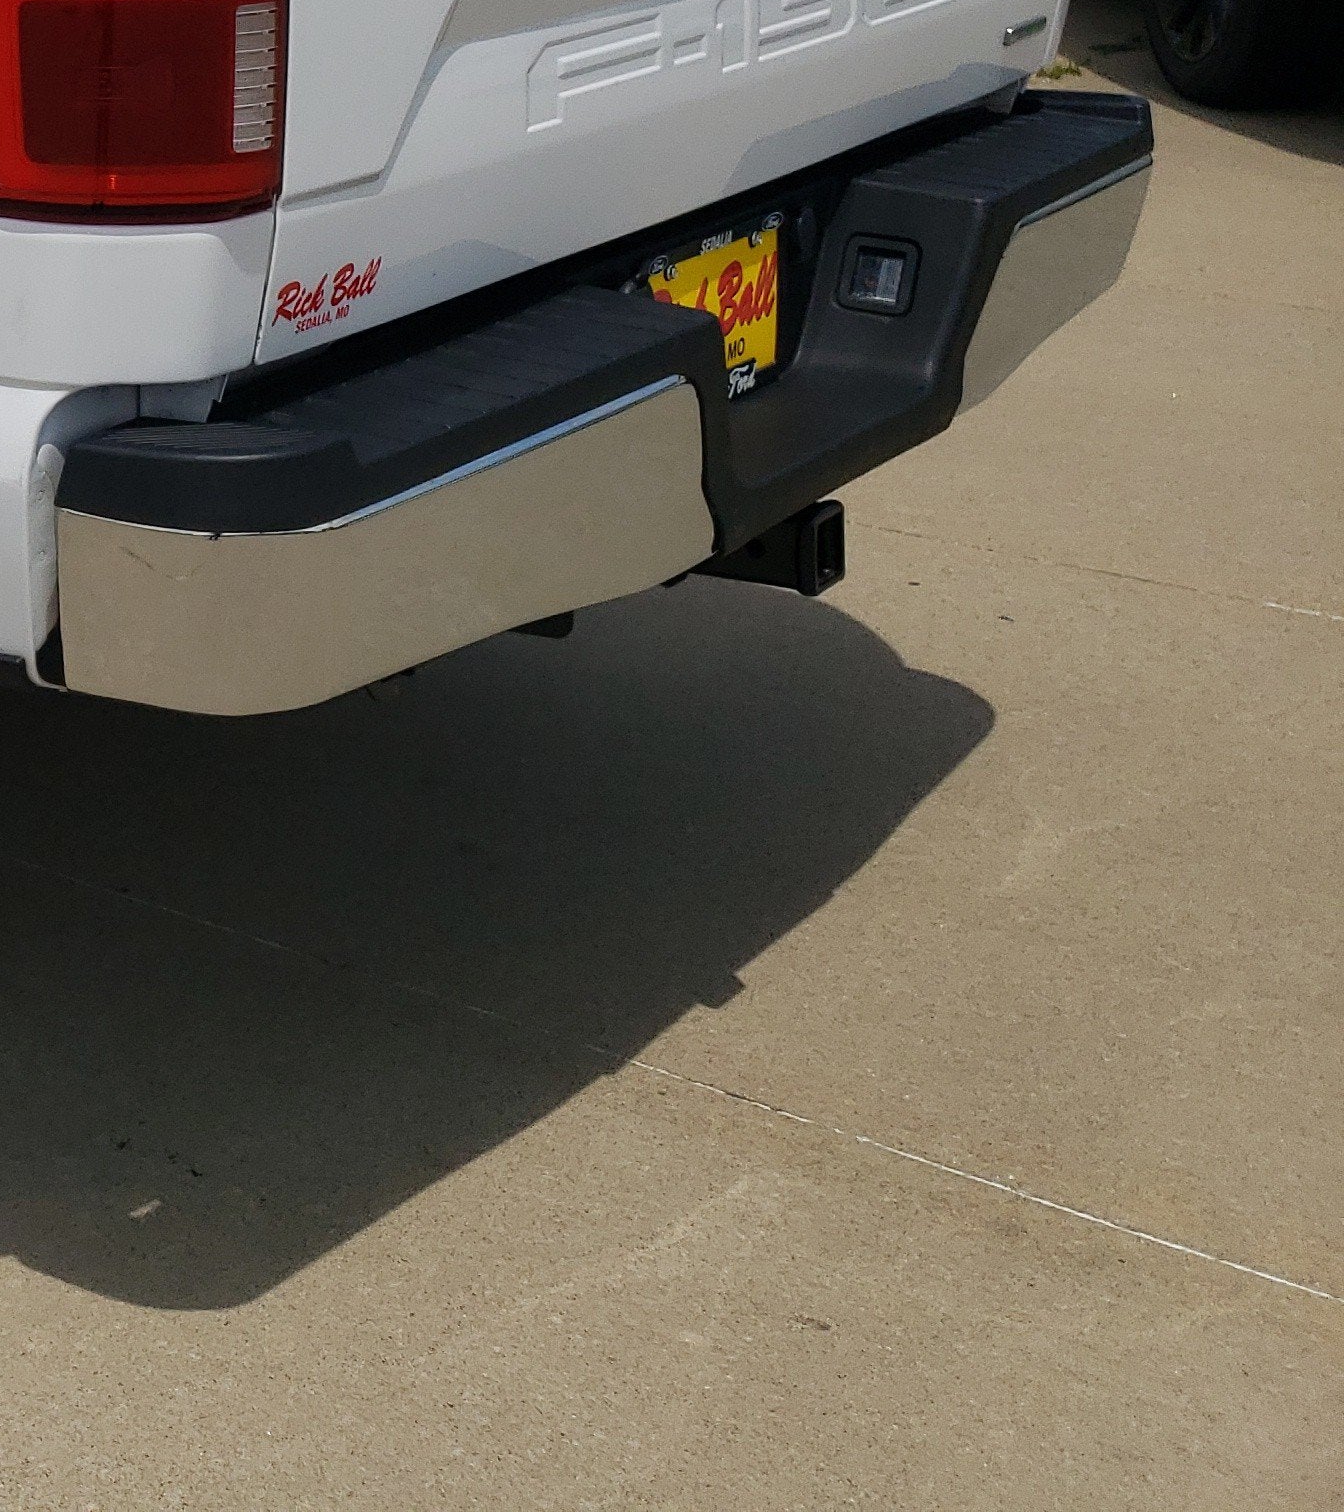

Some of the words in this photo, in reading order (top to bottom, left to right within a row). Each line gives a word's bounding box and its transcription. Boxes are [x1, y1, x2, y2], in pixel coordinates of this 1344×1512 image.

[700, 229, 733, 256] SEDALIA
[272, 281, 328, 327] Rick
[330, 256, 382, 307] Ball
[717, 250, 778, 337] Ball
[336, 305, 350, 320] MO
[727, 338, 746, 361] MO
